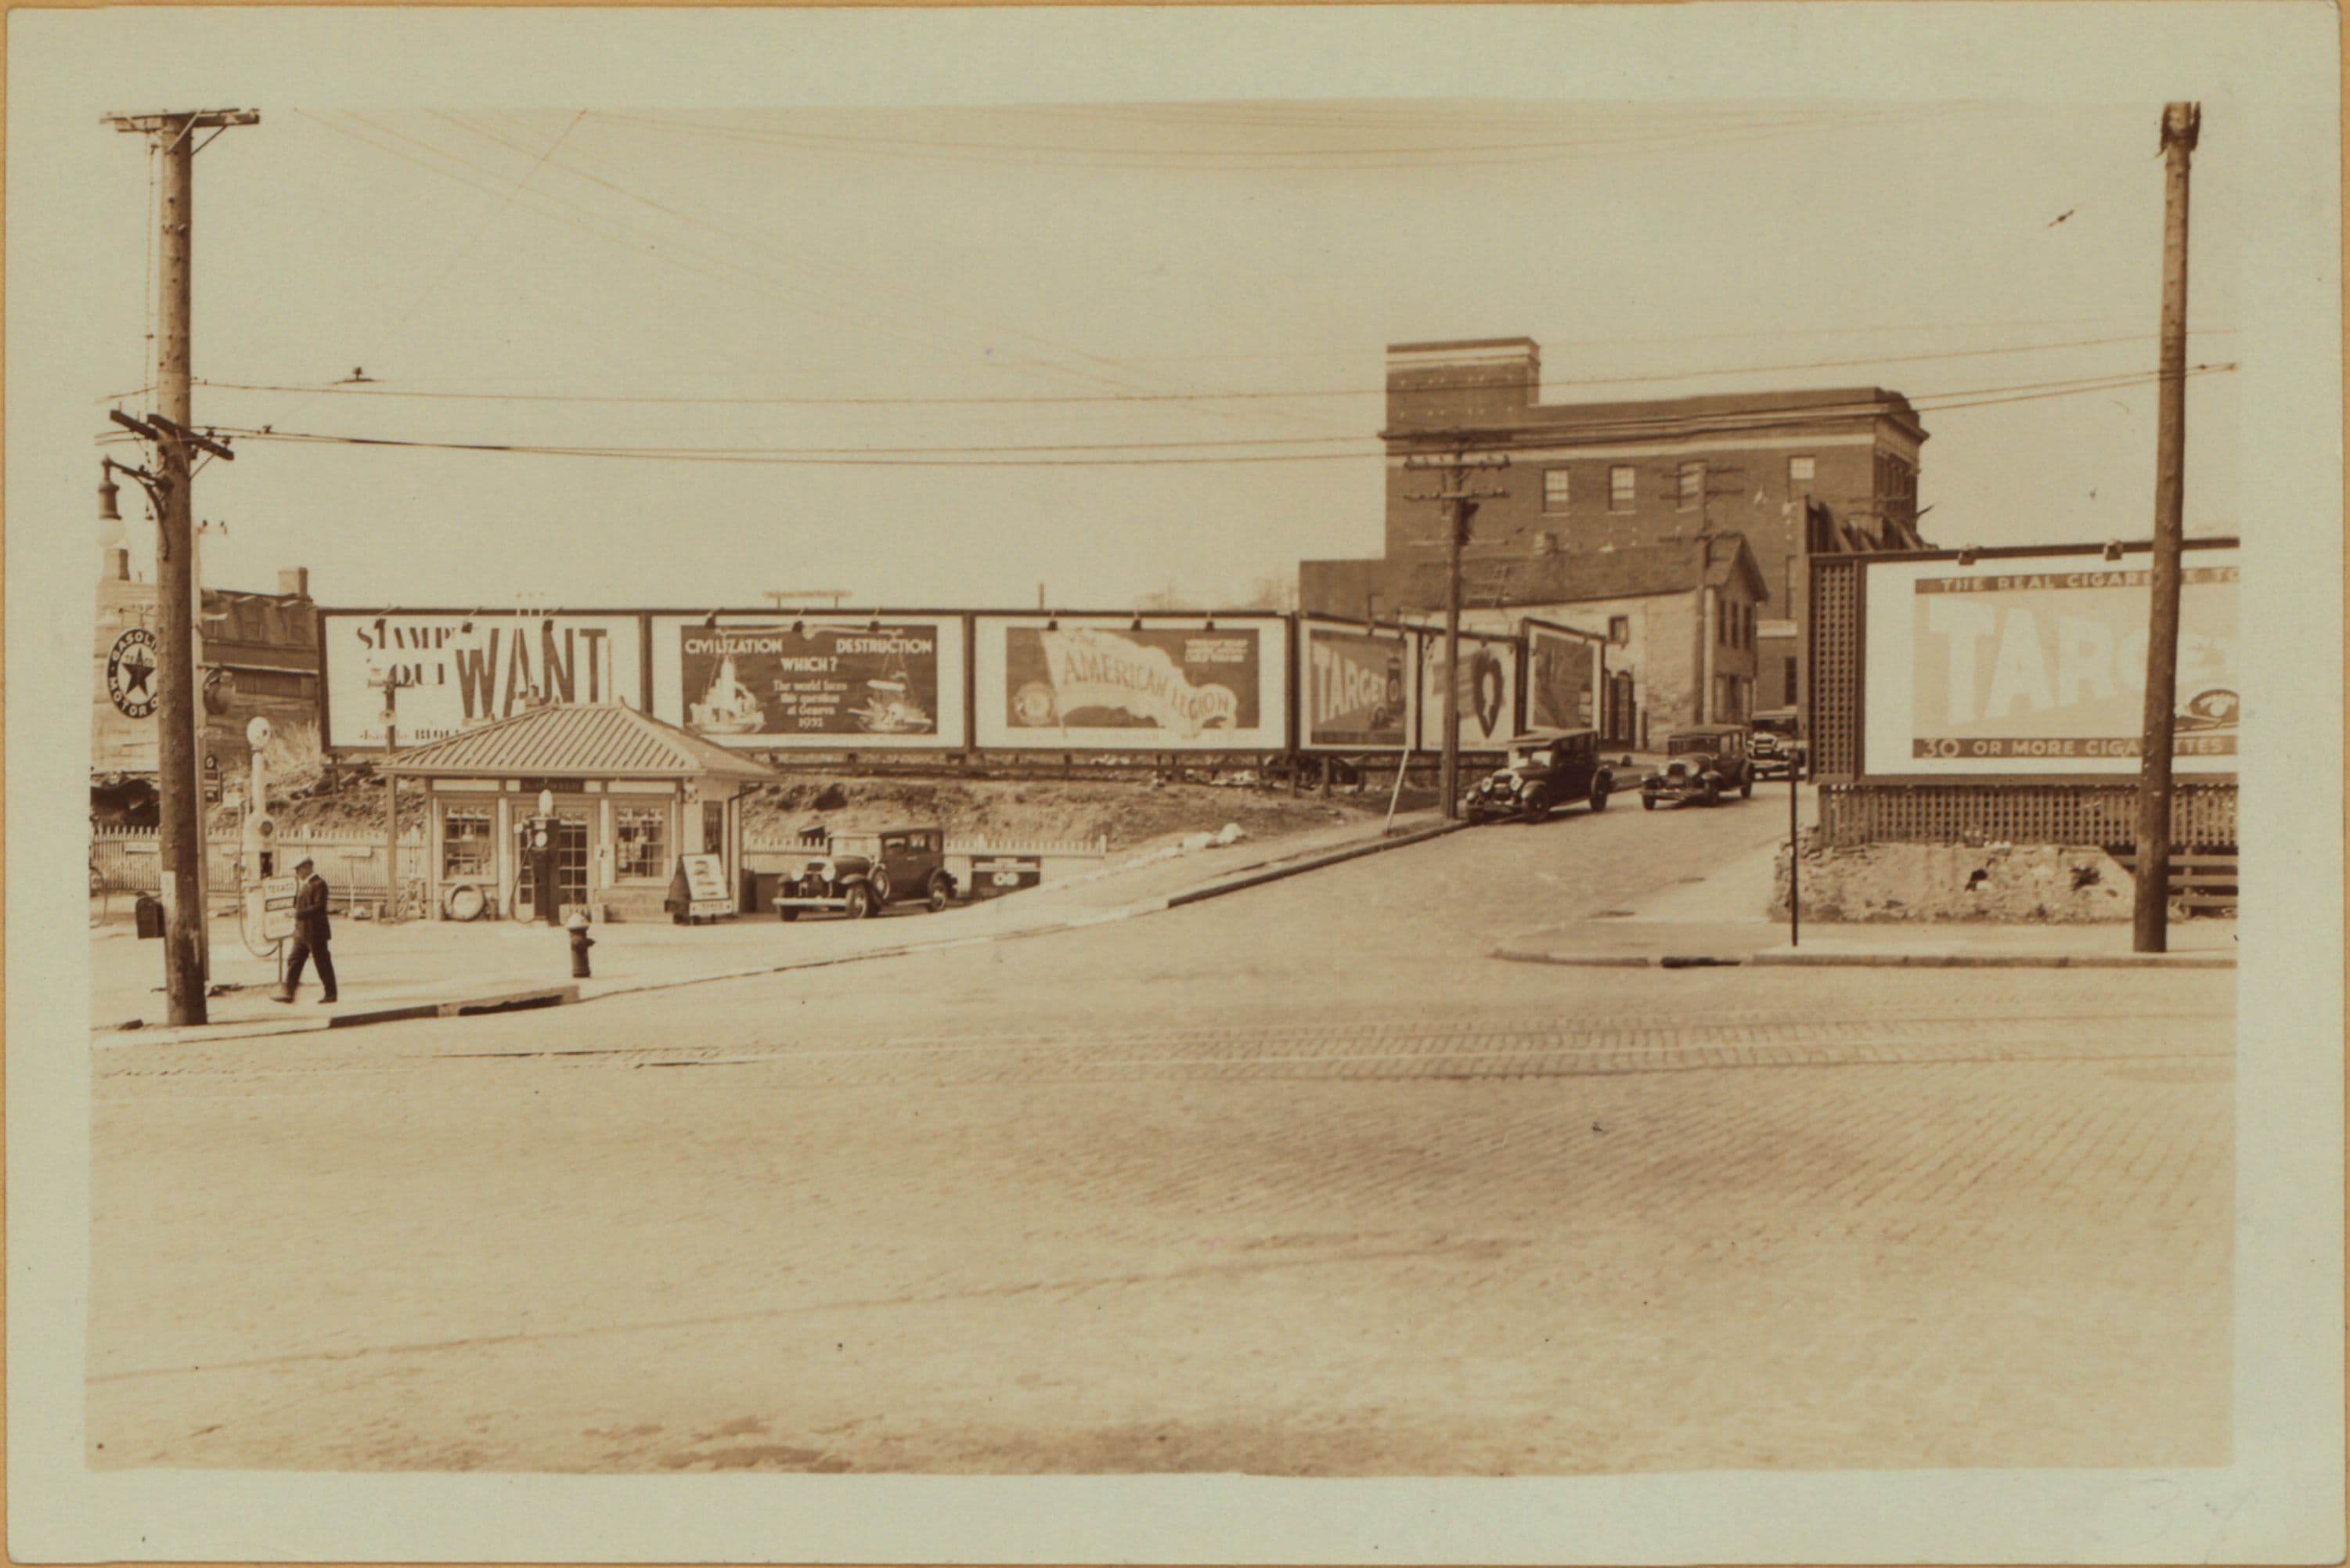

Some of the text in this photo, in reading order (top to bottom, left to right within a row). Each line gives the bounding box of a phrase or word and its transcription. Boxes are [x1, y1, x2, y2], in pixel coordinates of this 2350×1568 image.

[1941, 578, 1984, 593] THE
[1998, 575, 2054, 589] REAL
[2067, 568, 2196, 588] CIGAREE
[111, 630, 157, 662] GASOLI
[684, 638, 783, 654] CIVILIZATION
[835, 638, 933, 654] DESTRUCTION
[456, 628, 607, 719] WANT
[793, 679, 821, 691] world
[1063, 650, 1169, 697] AMERICAN
[1171, 687, 1230, 721] LEGION
[1313, 641, 1386, 723] TARGET
[108, 676, 147, 718] MOTOR
[798, 705, 835, 716] Geneva
[1922, 737, 2224, 759] 30 OR MORE CIGATTES
